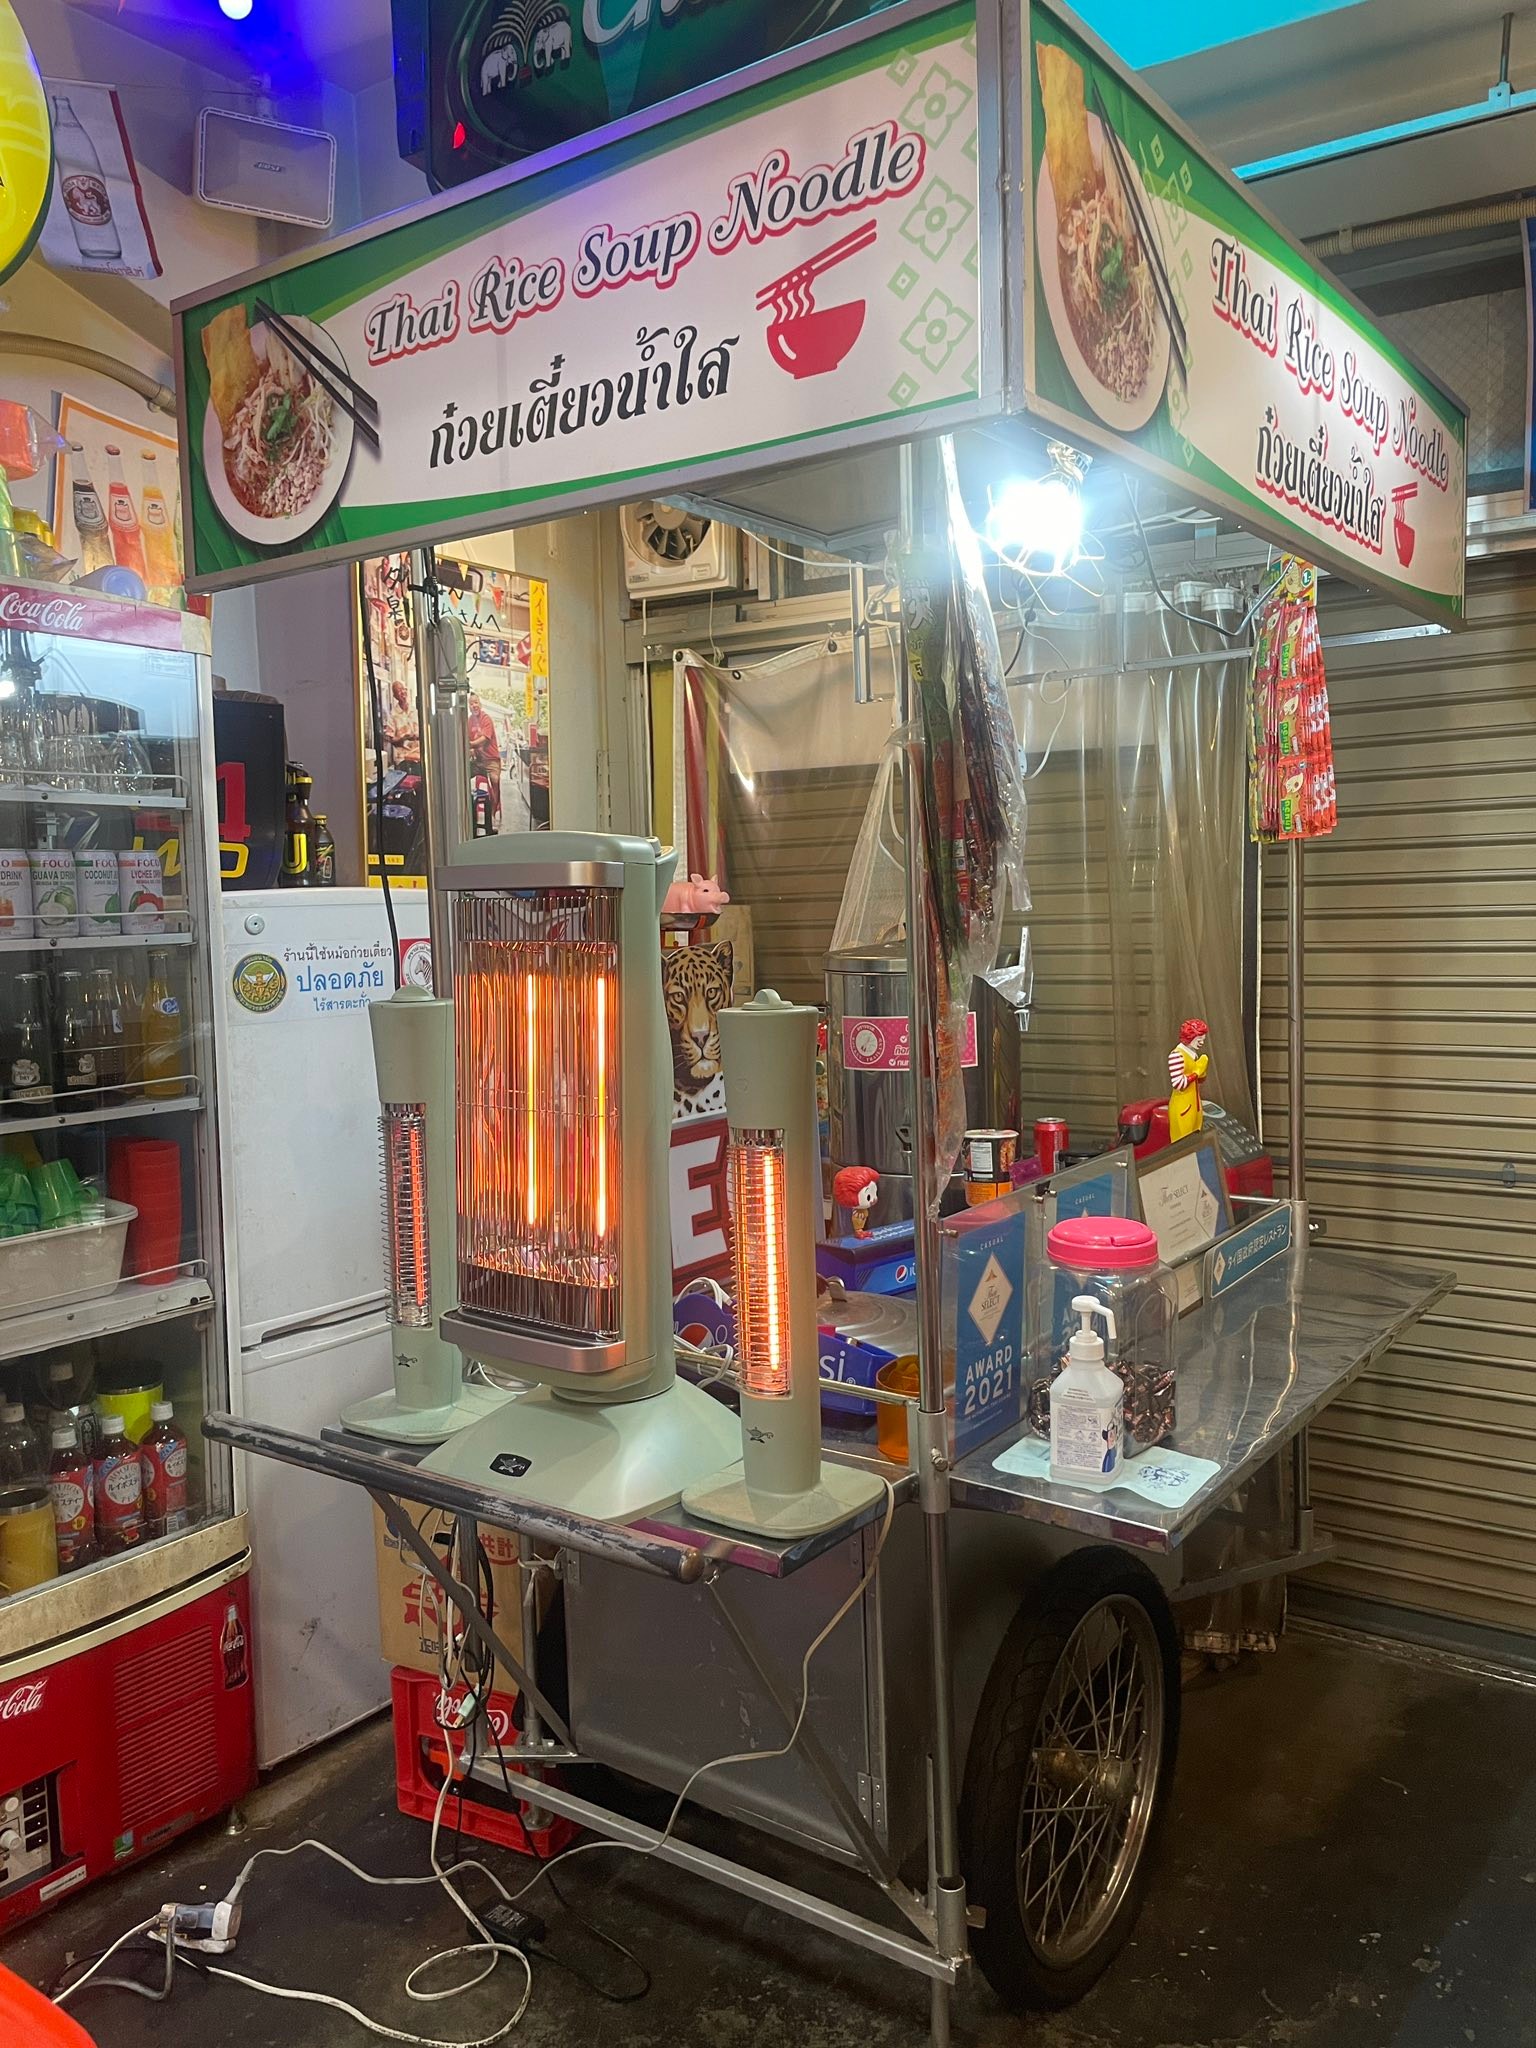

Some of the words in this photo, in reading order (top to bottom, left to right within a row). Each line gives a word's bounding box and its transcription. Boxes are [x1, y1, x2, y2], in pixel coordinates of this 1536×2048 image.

[368, 278, 454, 357] Thai
[472, 255, 558, 324] Rice
[576, 215, 693, 285] Soup
[712, 133, 917, 242] Noodle
[1211, 237, 1275, 343] Thai
[1286, 294, 1334, 389] Rice
[1340, 351, 1387, 440] Soup
[1393, 396, 1448, 482] Noodle
[429, 325, 740, 469] ก๋วยเตี๋ยวน้ำใส
[1257, 405, 1384, 544] ก๋วยเตี๋ยวน้ำใส
[0, 592, 87, 631] Coca-Cola
[32, 870, 59, 880] GUAVA
[42, 859, 70, 868] FOCO
[296, 960, 385, 992] ปลอดภัย
[979, 1237, 1004, 1251] CASUAL
[965, 1344, 1013, 1386] AWARD
[963, 1363, 1013, 1416] 2021
